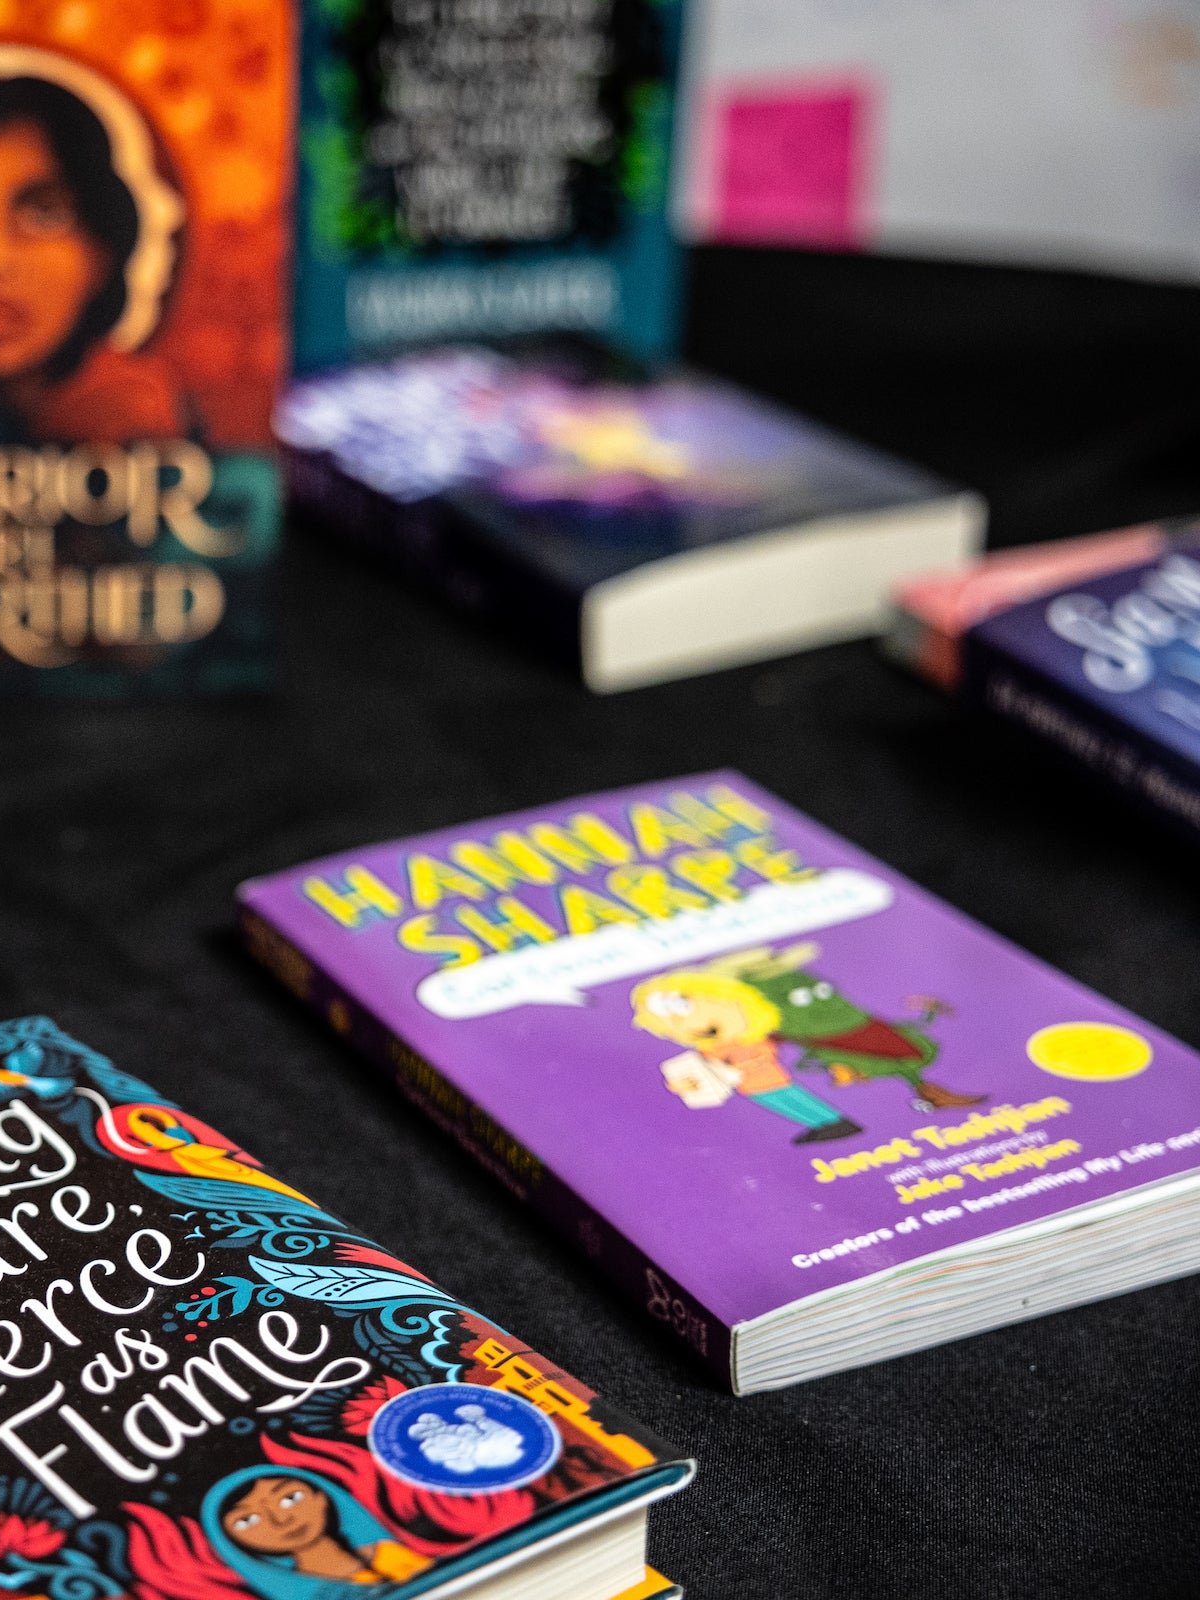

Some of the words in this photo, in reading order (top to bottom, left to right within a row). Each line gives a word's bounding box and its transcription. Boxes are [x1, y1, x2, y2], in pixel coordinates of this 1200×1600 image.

[302, 783, 773, 929] HANNAH
[397, 836, 823, 970] SHARPE
[791, 1226, 894, 1269] Creators
[894, 1214, 922, 1235] of
[921, 1205, 963, 1226] the
[961, 1166, 1089, 1213] bestselling
[1083, 1154, 1122, 1175] My
[1118, 1141, 1166, 1164] Life
[811, 1137, 922, 1184] Janet
[895, 1173, 965, 1204] Jake
[80, 1325, 169, 1395] as
